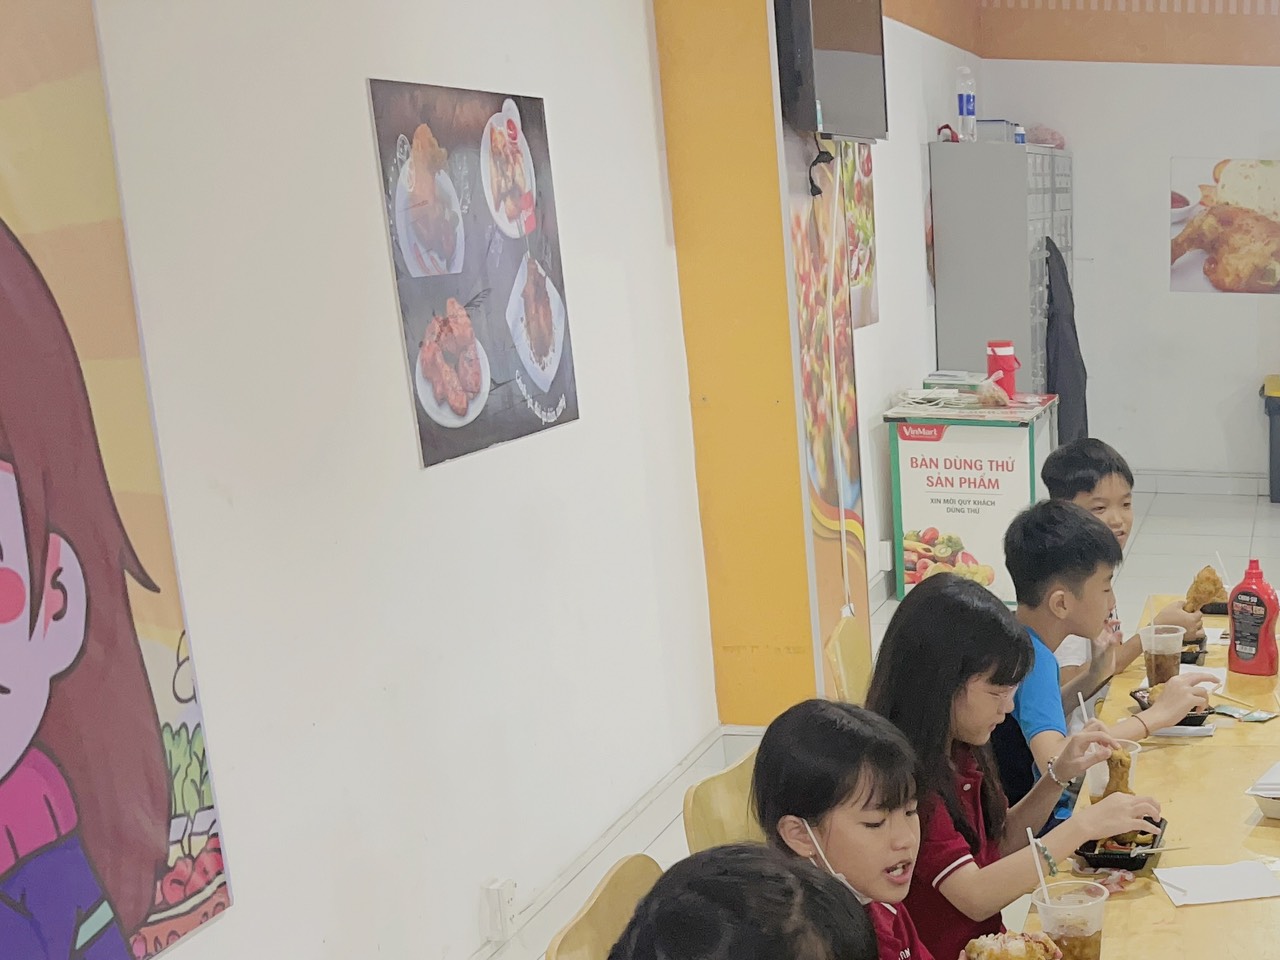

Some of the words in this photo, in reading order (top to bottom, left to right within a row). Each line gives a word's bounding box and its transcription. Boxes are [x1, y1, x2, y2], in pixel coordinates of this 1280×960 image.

[903, 426, 938, 436] VinMart
[910, 454, 939, 470] BÀN
[943, 455, 983, 471] DÙNG
[987, 456, 1015, 472] THỬ
[926, 472, 954, 488] SẢN
